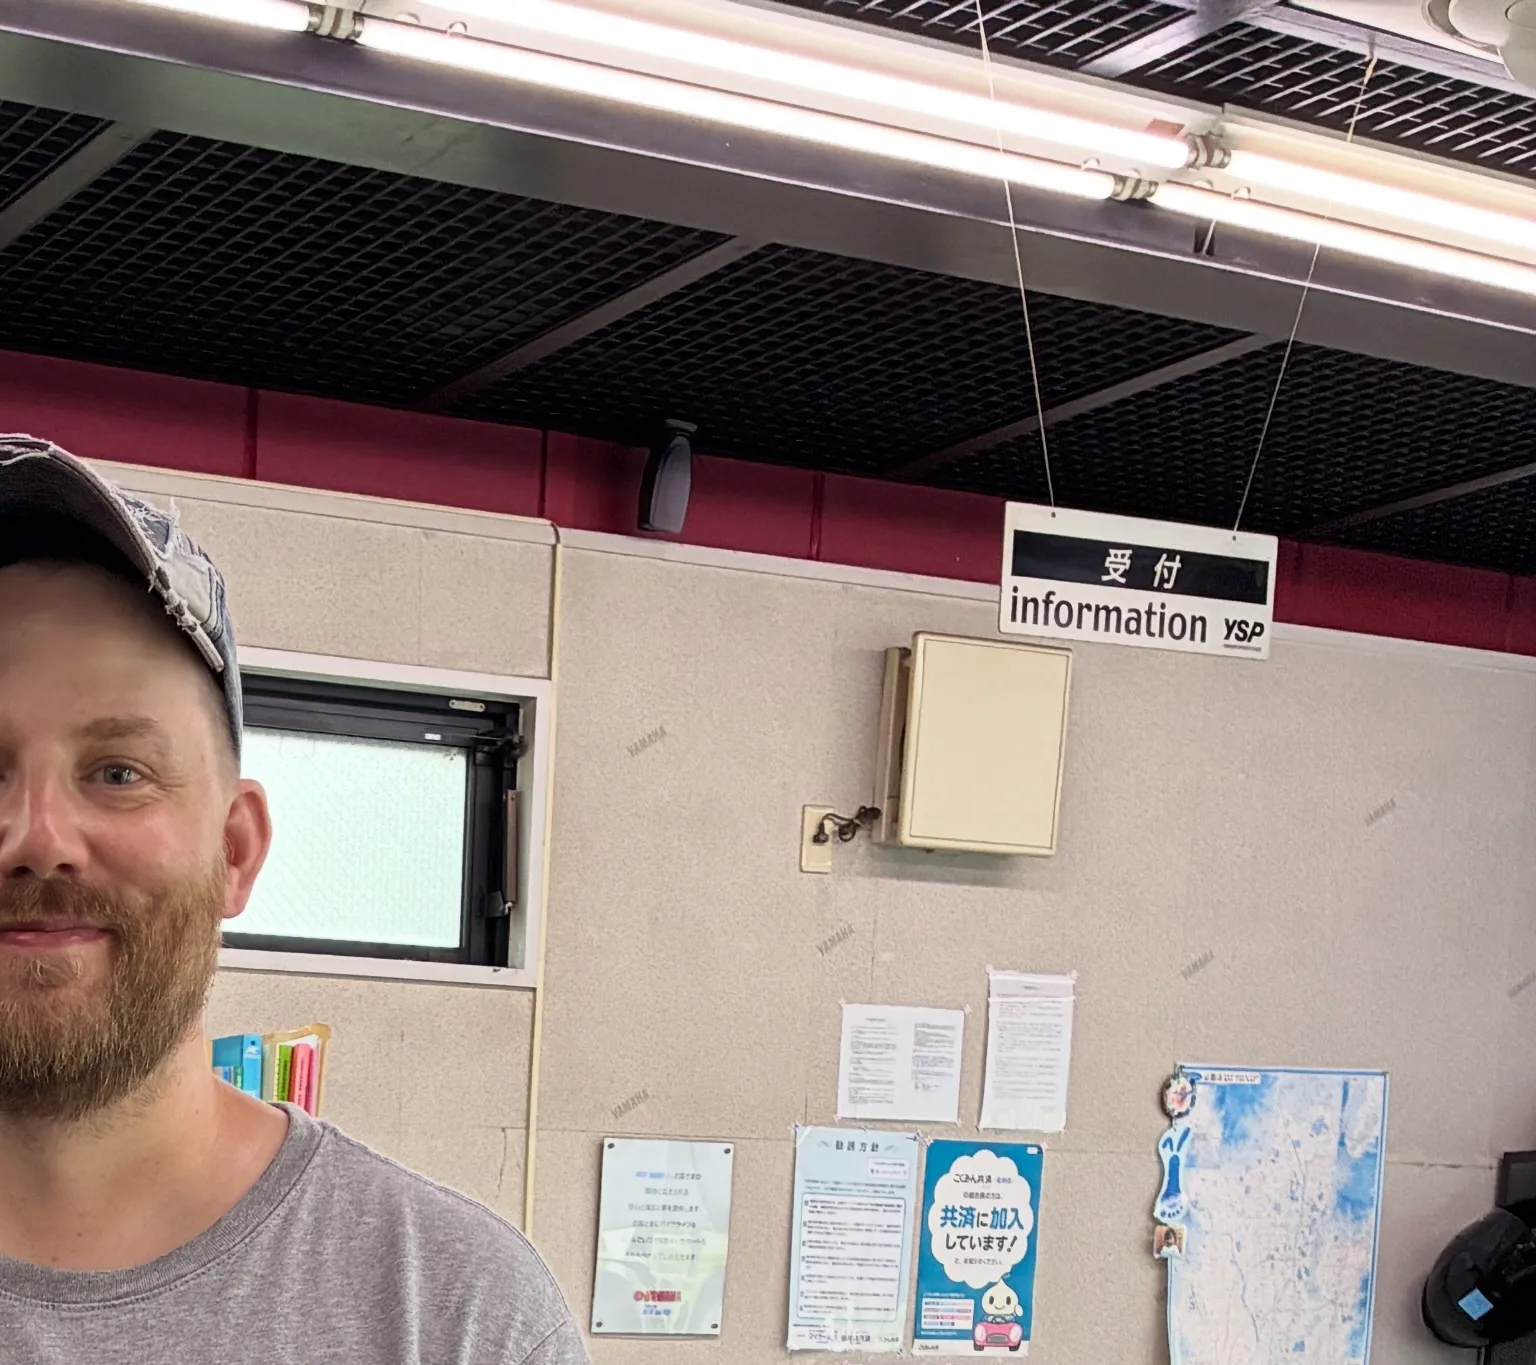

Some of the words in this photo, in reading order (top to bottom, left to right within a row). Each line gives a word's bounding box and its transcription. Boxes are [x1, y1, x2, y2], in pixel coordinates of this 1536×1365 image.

[1101, 548, 1182, 589] 受付
[1011, 585, 1207, 643] information
[1223, 617, 1265, 643] YSP
[940, 1205, 1024, 1230] 共済に加入
[946, 1233, 1018, 1253] しています!
